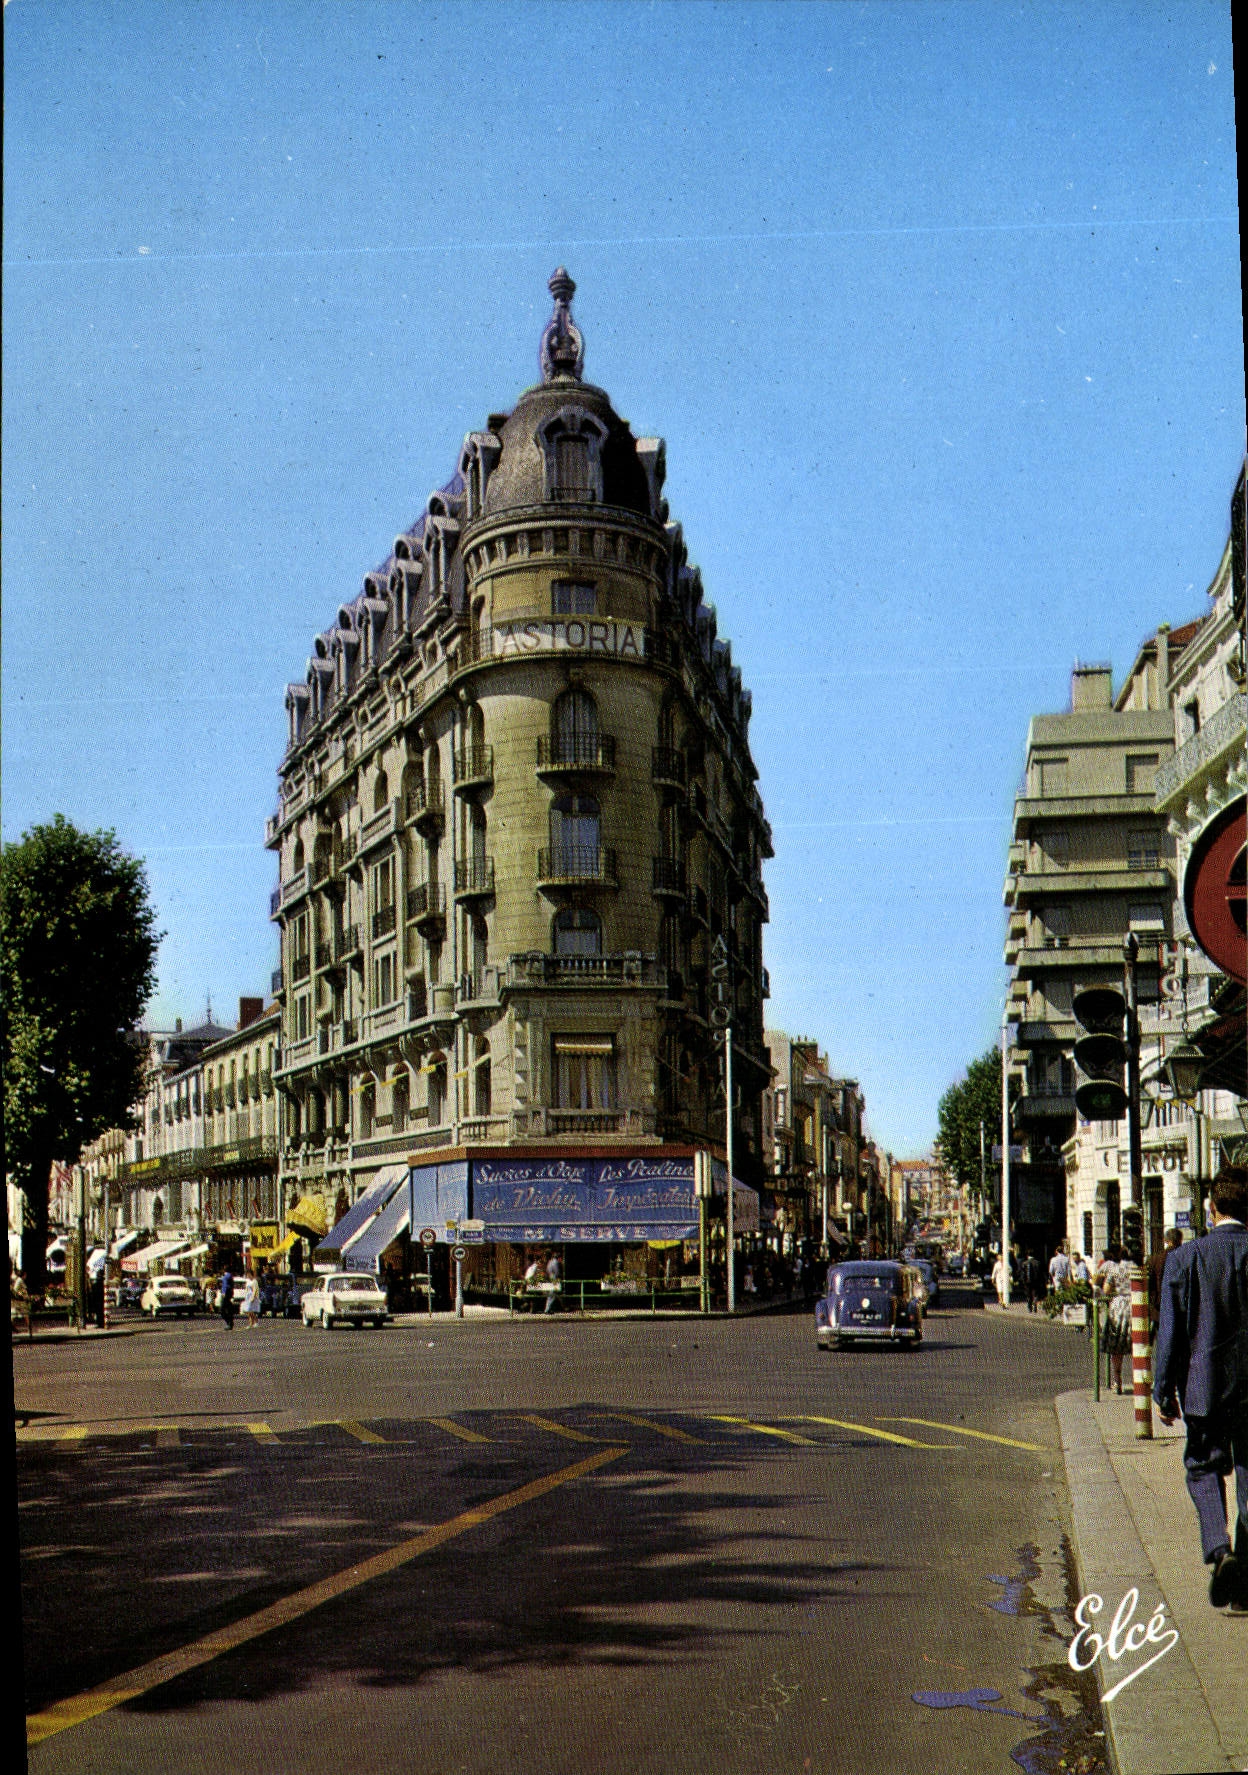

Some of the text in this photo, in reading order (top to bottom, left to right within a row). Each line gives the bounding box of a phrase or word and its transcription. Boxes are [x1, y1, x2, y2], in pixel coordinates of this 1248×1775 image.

[500, 620, 640, 655] ASTORIA
[1159, 942, 1184, 1094] HOTL
[628, 1159, 695, 1178] Praline
